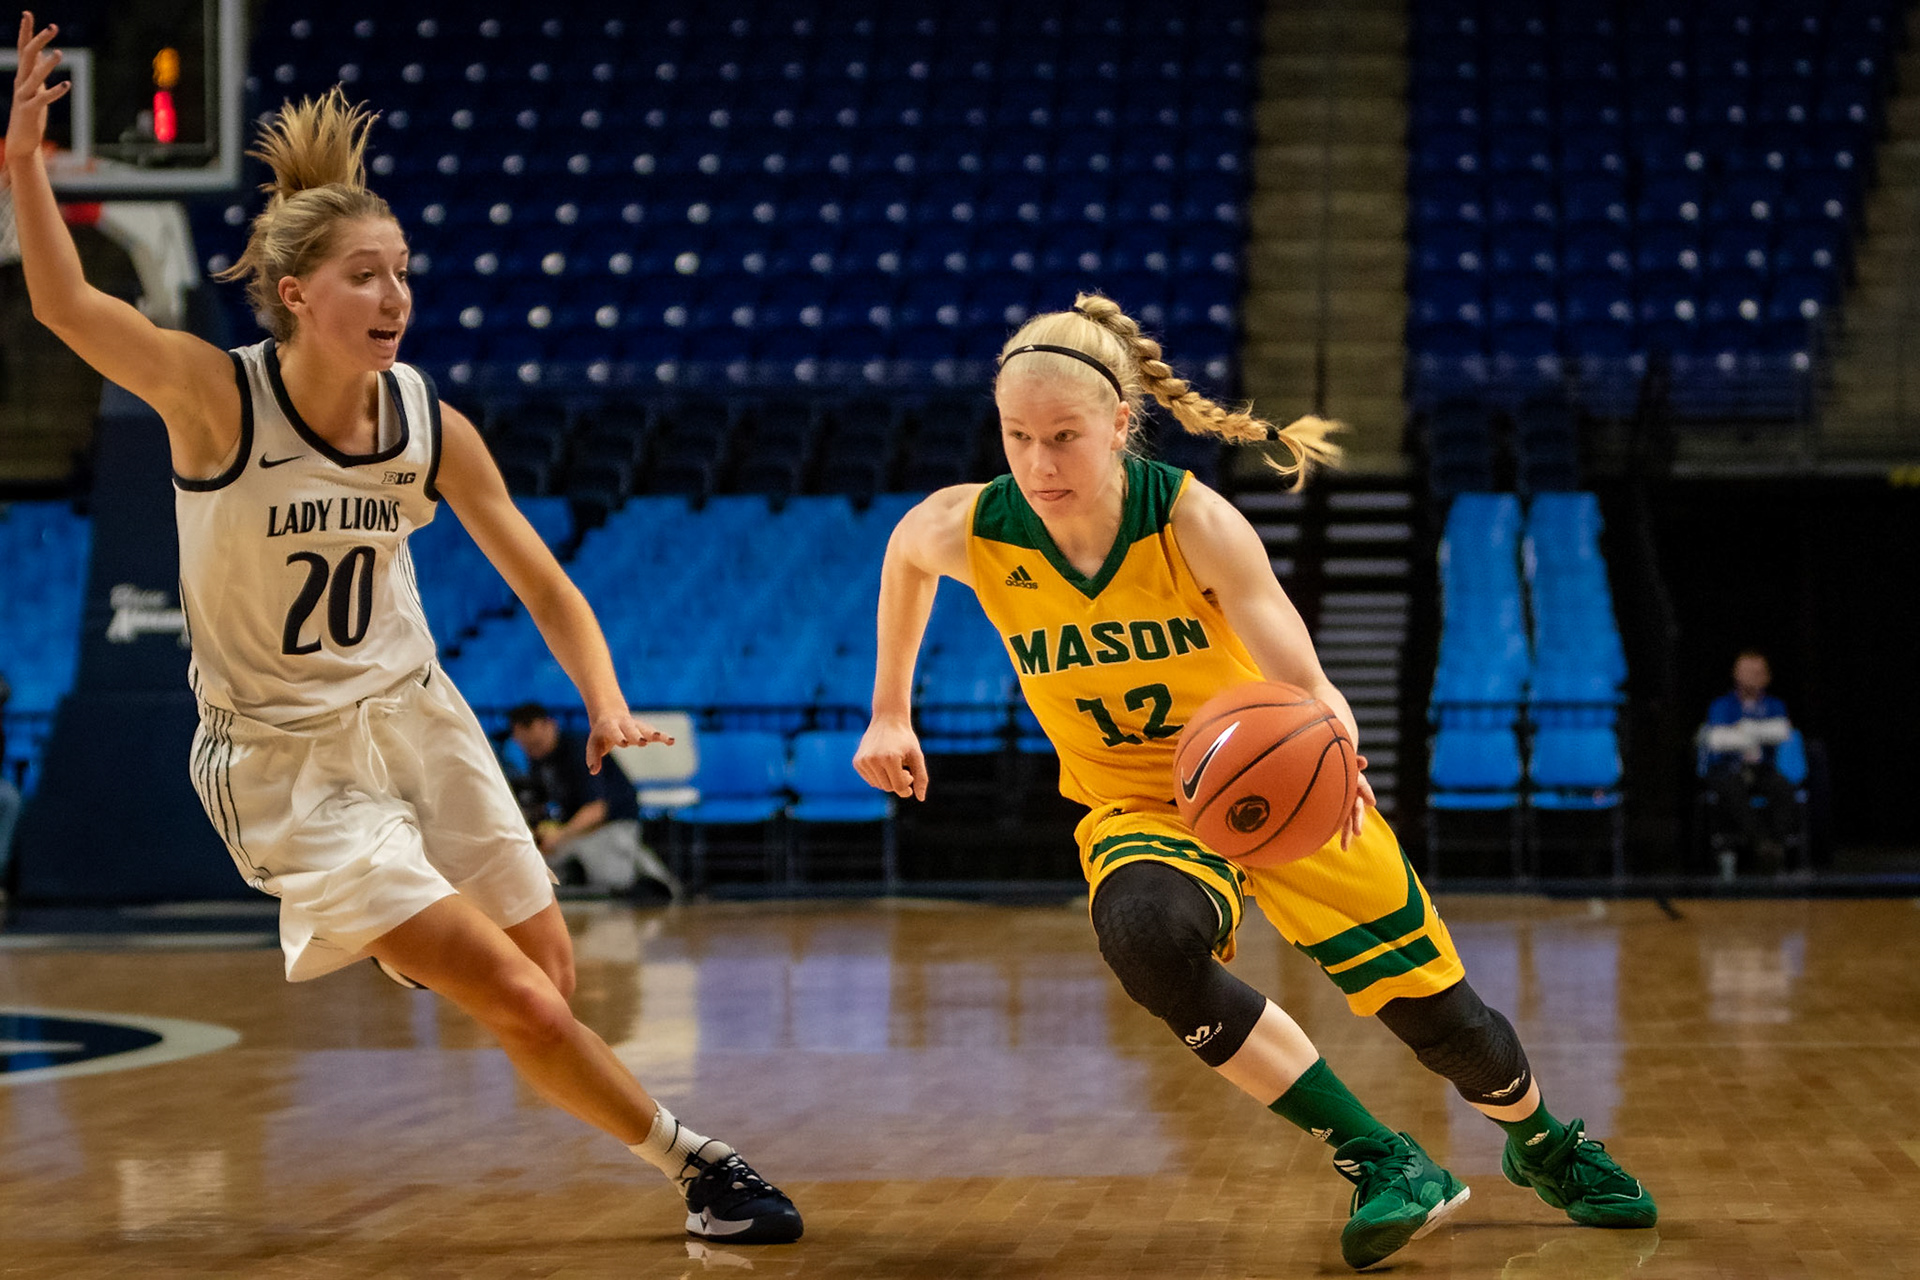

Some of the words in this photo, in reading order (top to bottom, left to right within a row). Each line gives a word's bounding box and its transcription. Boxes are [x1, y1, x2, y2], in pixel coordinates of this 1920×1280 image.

[266, 498, 333, 538] LADY
[339, 497, 400, 533] LIONS
[281, 545, 376, 656] 20
[1009, 616, 1210, 675] MASON
[1075, 683, 1184, 747] 12
